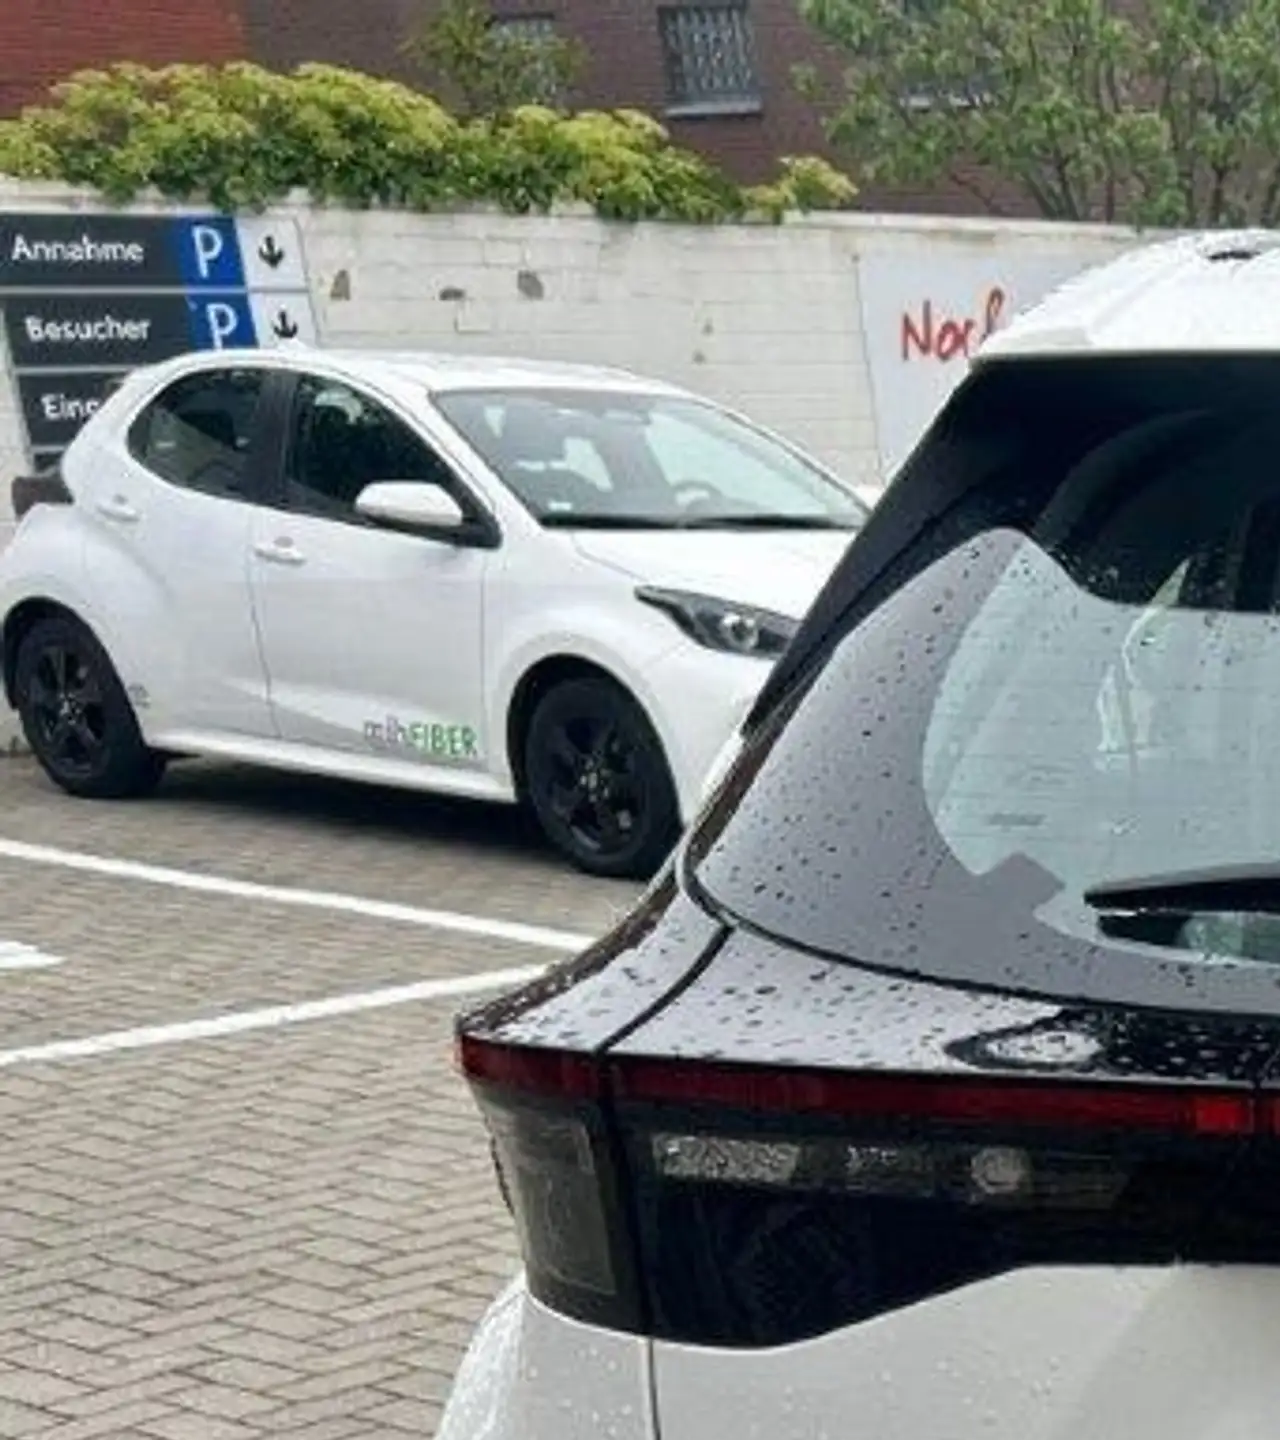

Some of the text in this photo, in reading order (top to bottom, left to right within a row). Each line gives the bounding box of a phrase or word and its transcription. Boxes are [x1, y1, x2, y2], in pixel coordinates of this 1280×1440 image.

[12, 224, 223, 279] Annahme P
[25, 303, 238, 350] Besucher P
